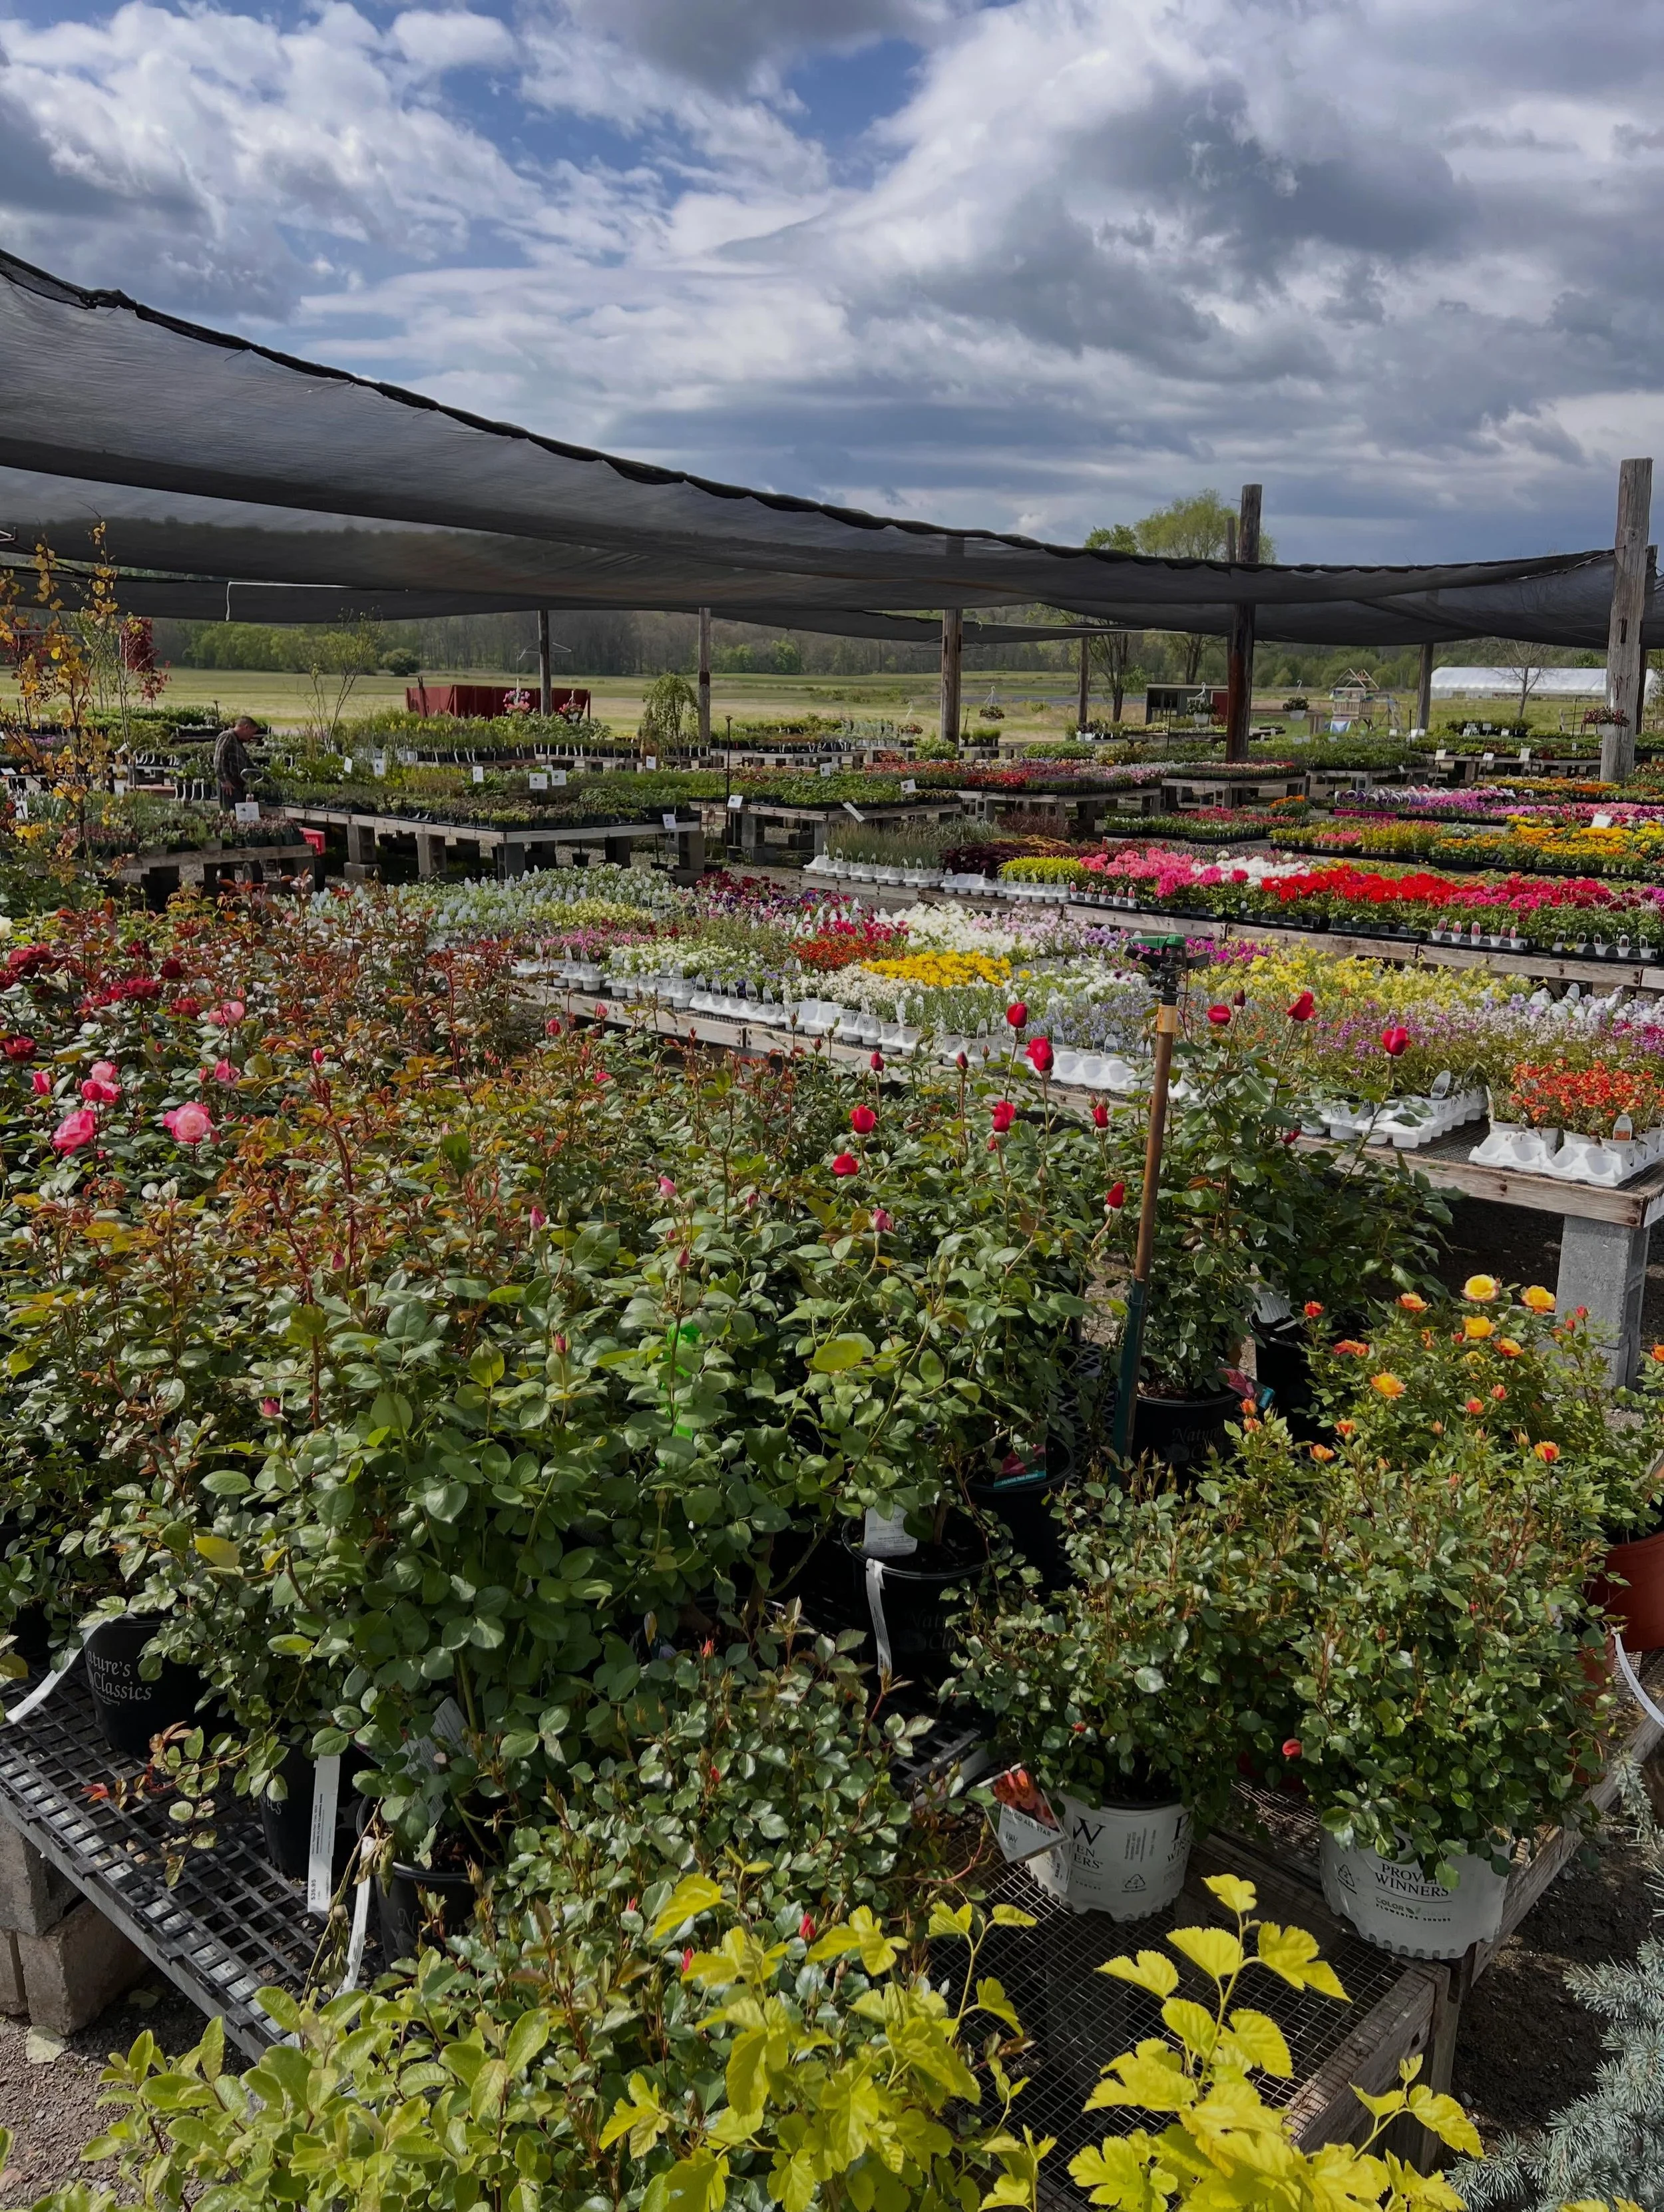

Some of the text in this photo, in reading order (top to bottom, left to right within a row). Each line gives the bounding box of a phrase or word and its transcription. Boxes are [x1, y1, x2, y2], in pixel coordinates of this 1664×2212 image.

[87, 1650, 132, 1677] ature's
[93, 1671, 152, 1701] Classics
[1374, 1872, 1450, 1896] WINNERS
[1382, 1863, 1438, 1884] PROV
[1375, 1897, 1404, 1912] COLOR
